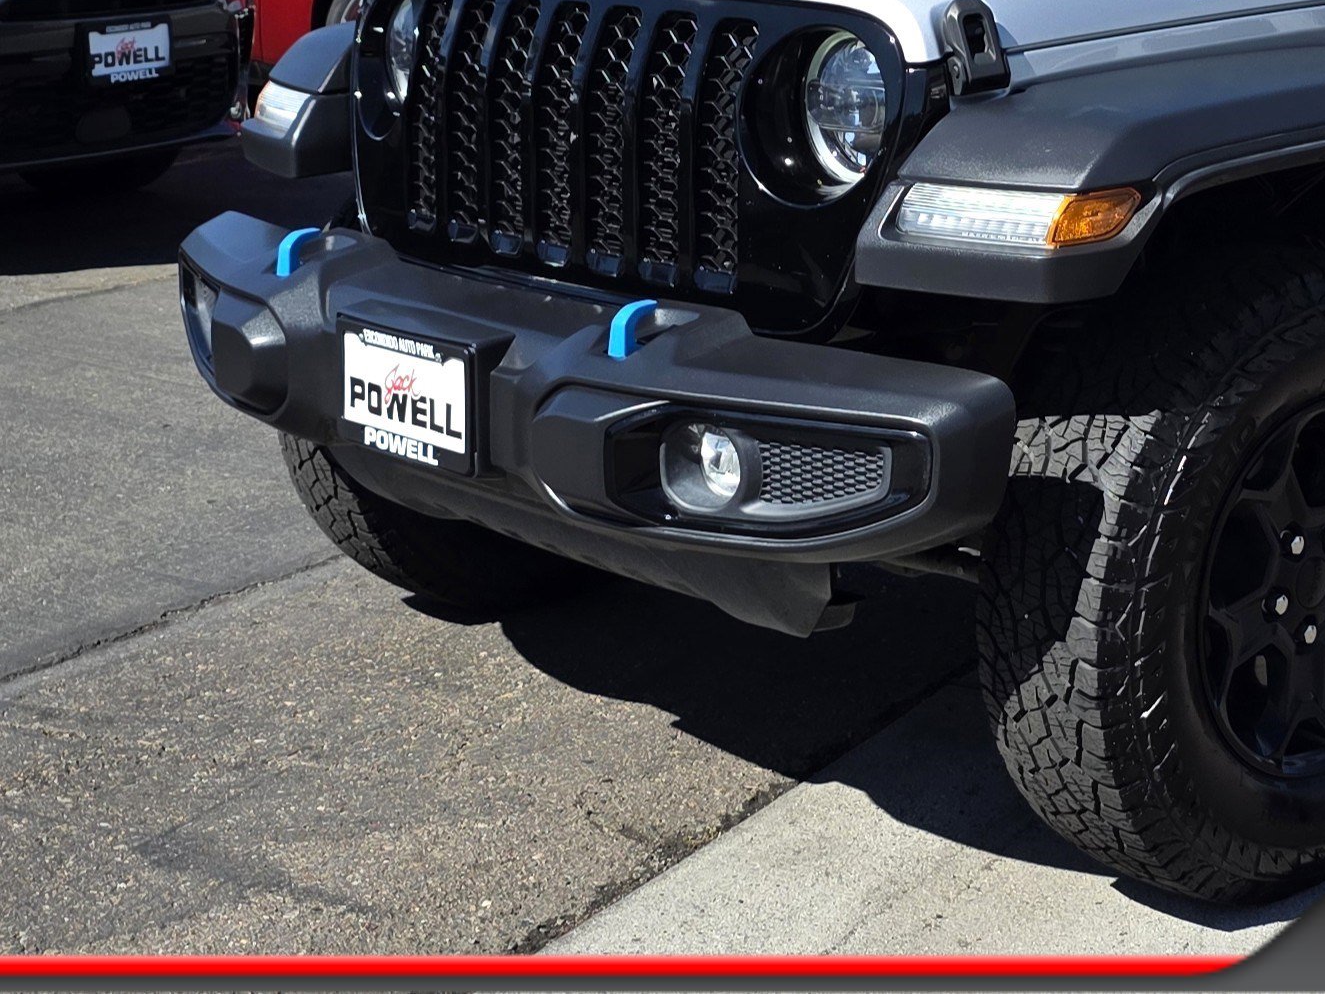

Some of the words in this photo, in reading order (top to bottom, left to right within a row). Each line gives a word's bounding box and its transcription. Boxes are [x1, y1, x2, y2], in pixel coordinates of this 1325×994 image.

[91, 45, 166, 70] POWELL
[110, 67, 159, 84] POWELL
[384, 363, 421, 404] Jack
[349, 376, 463, 440] POWELL
[364, 426, 439, 466] POWELL
